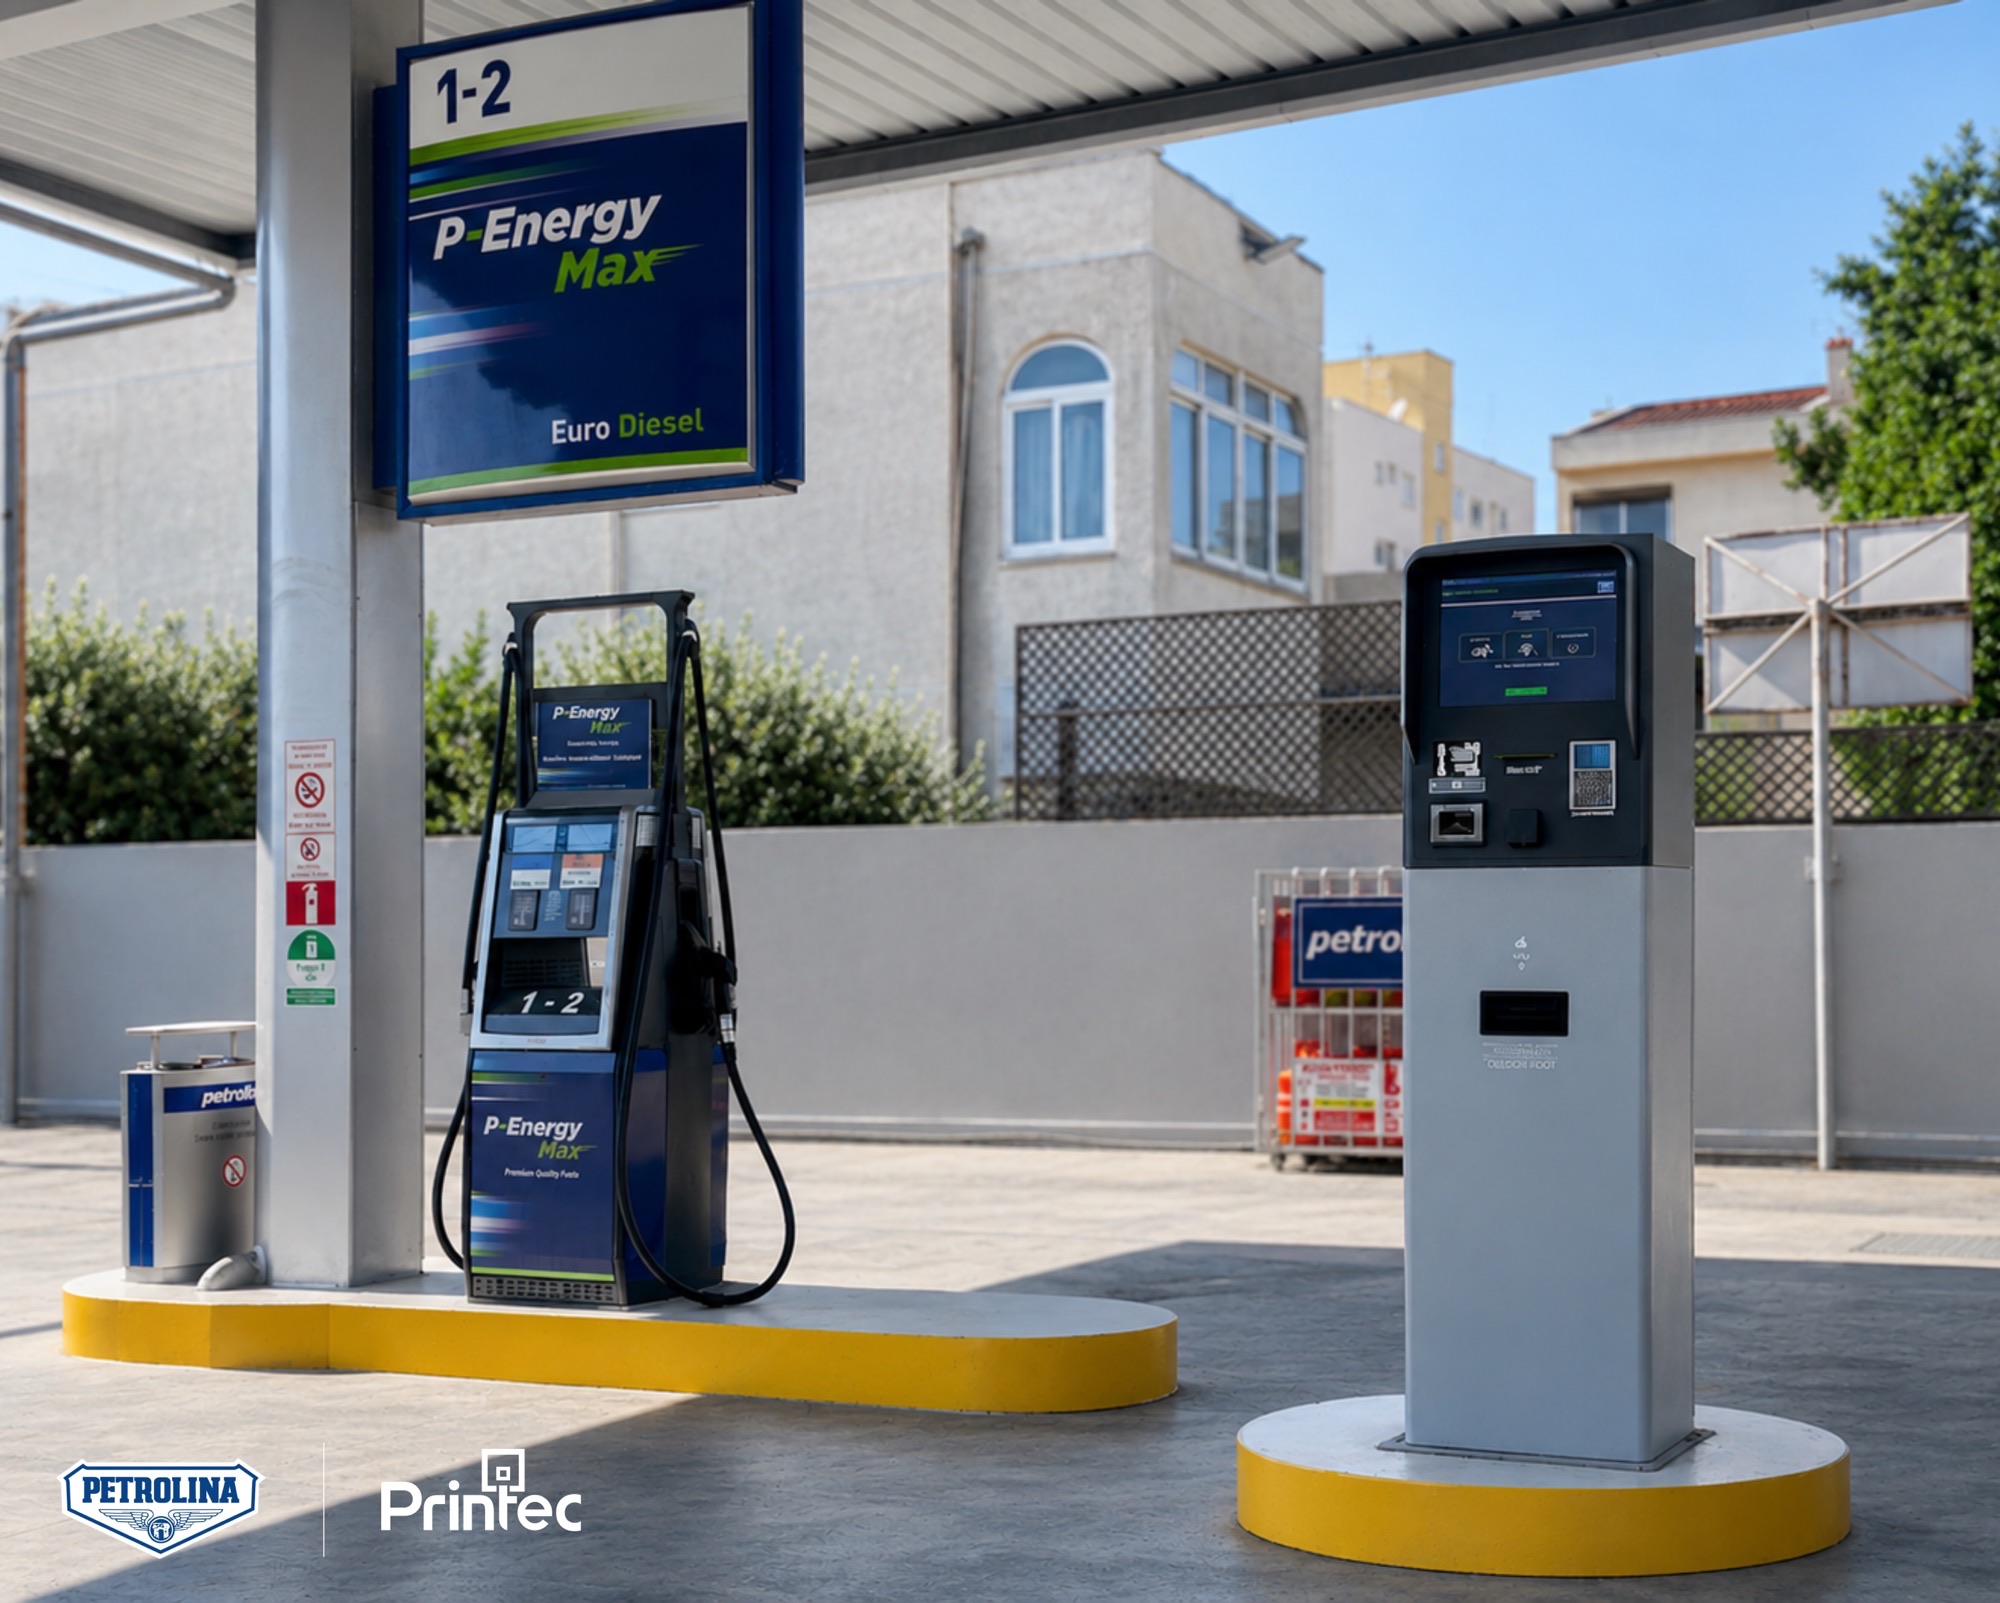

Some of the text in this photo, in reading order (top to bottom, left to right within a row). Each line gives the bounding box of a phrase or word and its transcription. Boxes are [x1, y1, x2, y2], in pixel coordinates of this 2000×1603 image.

[436, 59, 512, 124] 1-2
[432, 194, 662, 261] P-Energy
[553, 243, 692, 293] Max
[551, 408, 704, 445] Euro Diesel
[552, 705, 620, 721] P-Energy
[483, 1115, 583, 1141] P-Energy
[537, 1140, 594, 1160] Max
[504, 1168, 534, 1177] Premium
